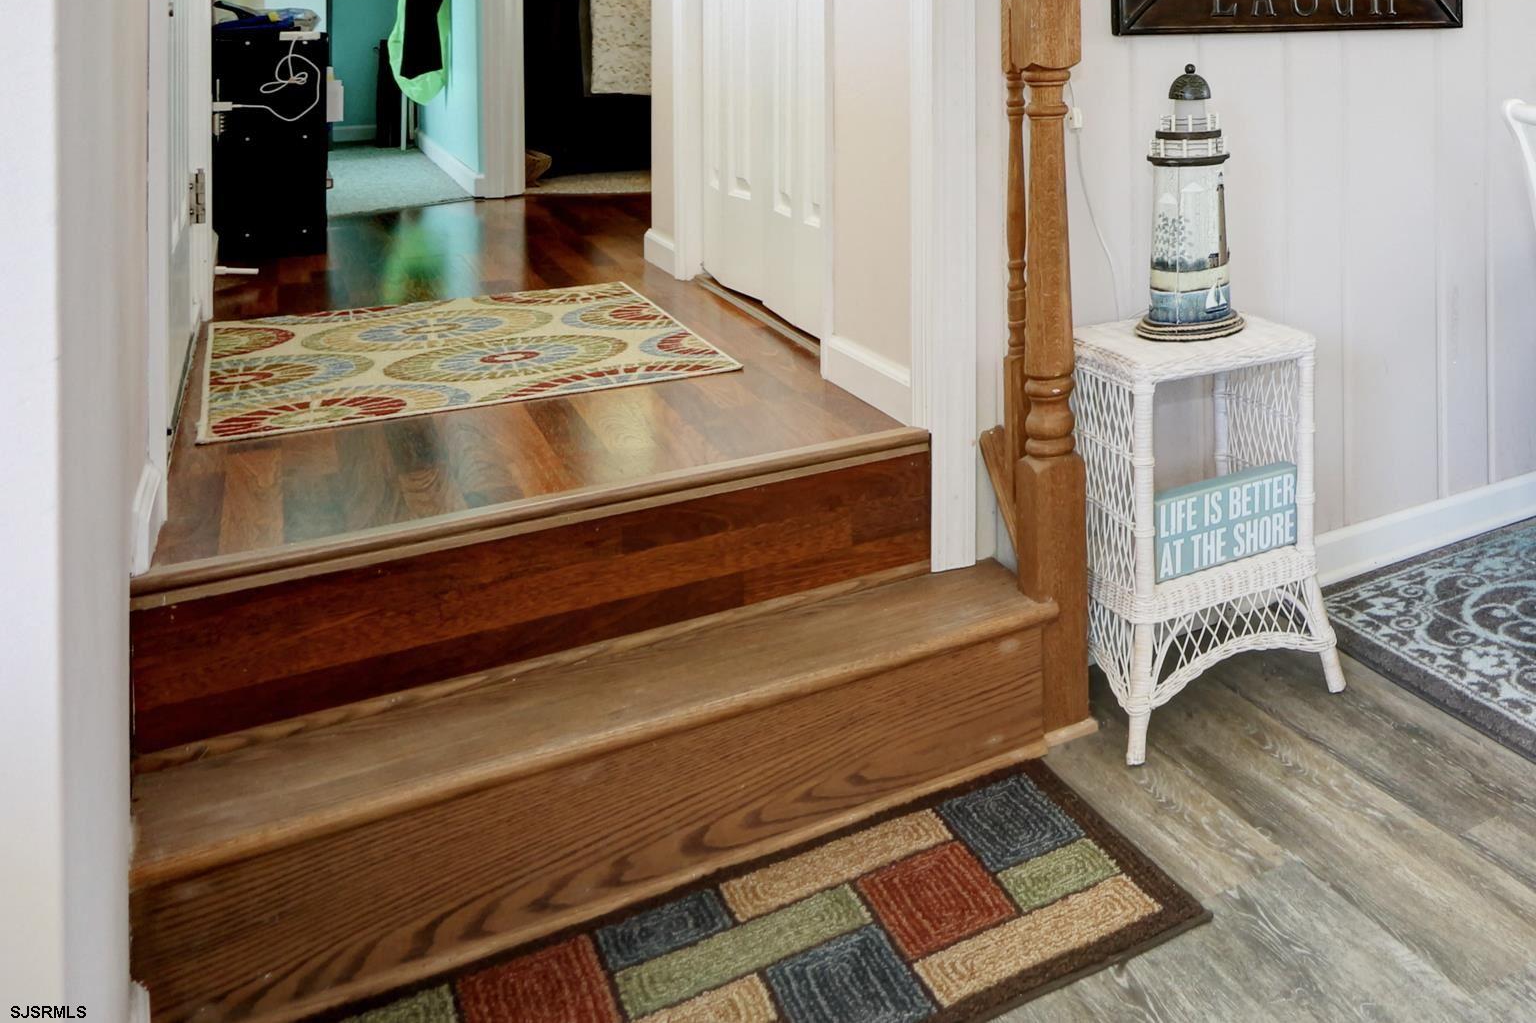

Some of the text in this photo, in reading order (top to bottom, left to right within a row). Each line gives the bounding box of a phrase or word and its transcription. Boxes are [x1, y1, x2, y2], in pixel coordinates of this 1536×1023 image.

[1160, 473, 1295, 539] LIFE IS BETTER
[1159, 509, 1295, 579] AT THE SHORE
